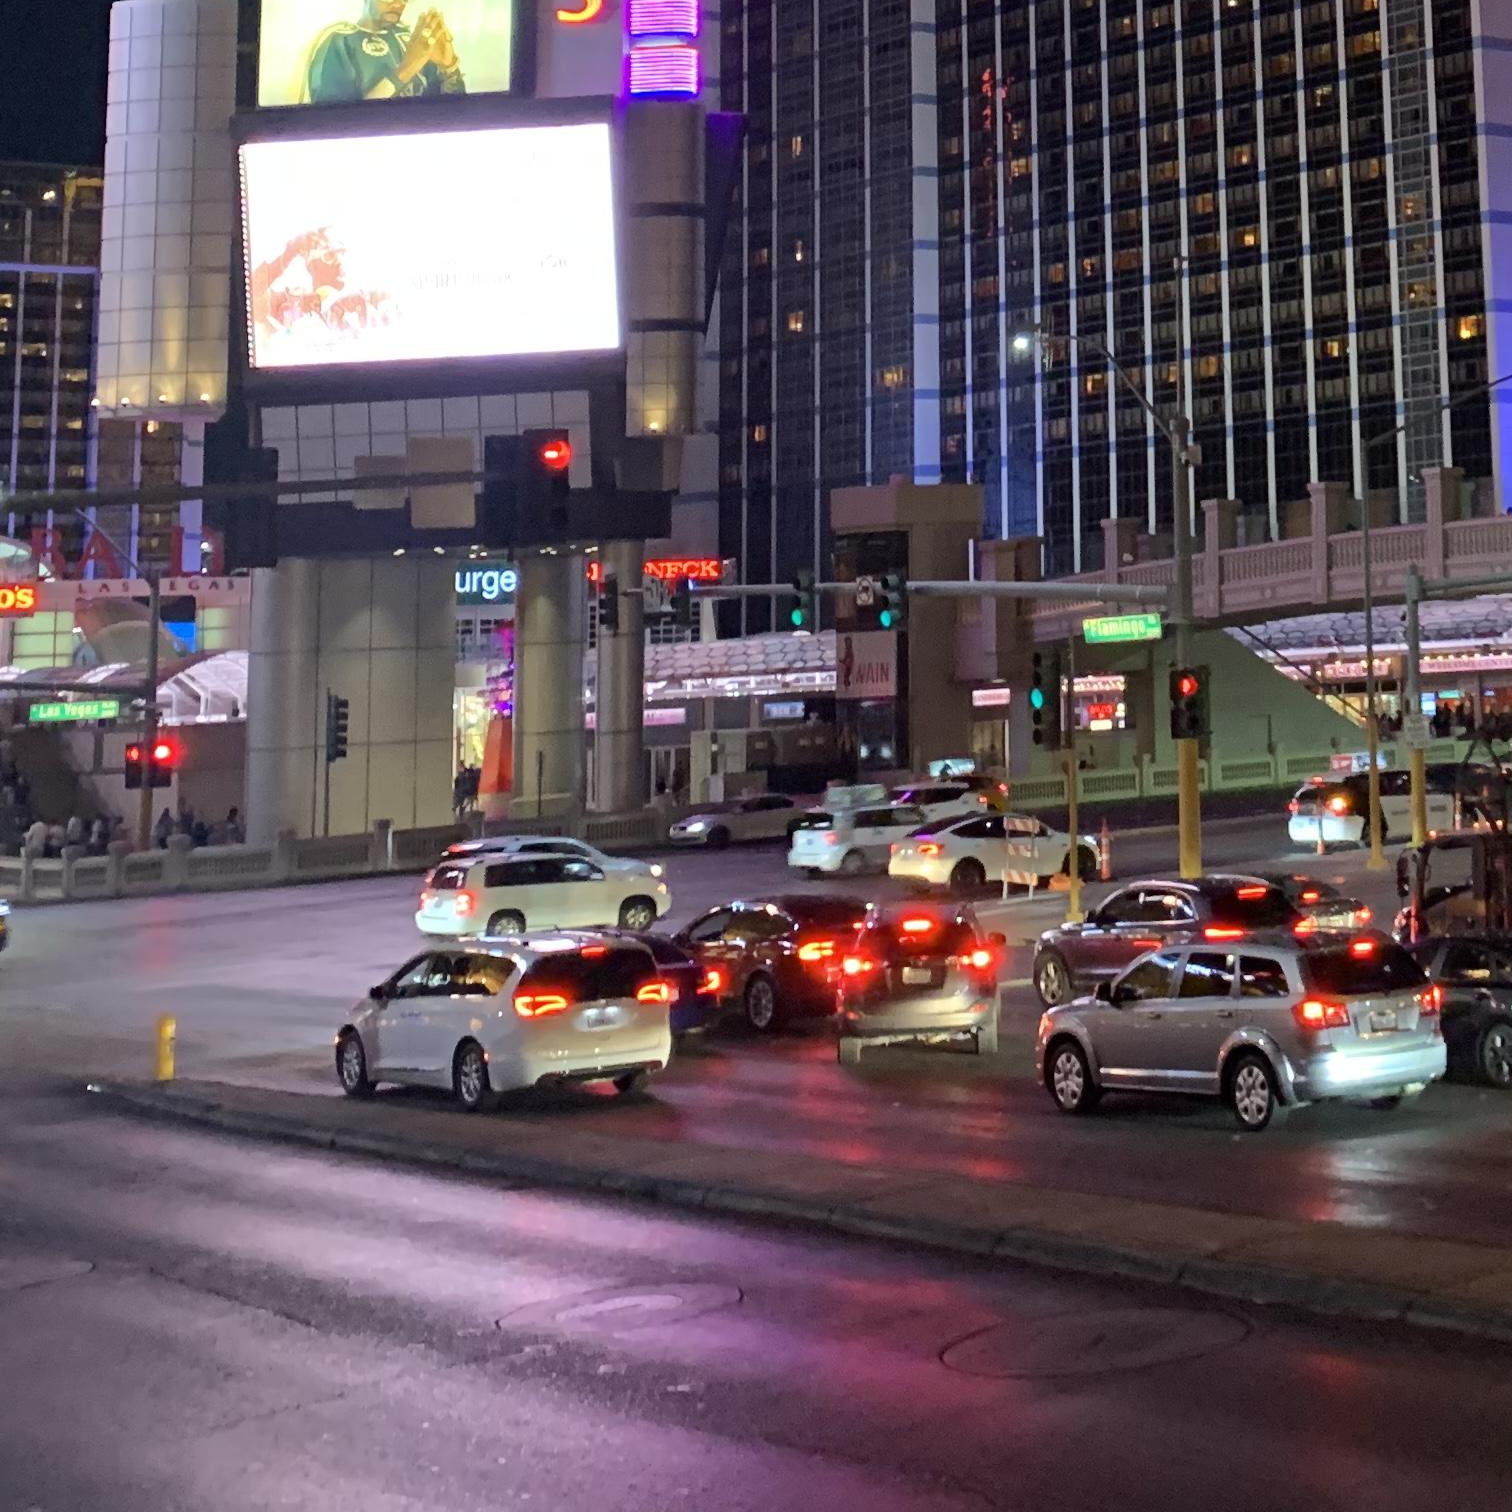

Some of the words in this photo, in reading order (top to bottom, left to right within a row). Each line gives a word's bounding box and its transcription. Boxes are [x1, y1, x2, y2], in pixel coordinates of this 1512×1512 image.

[643, 560, 719, 580] NECK
[166, 578, 236, 592] EGAS
[455, 569, 517, 599] urge
[1090, 620, 1146, 638] Flamingo
[39, 705, 61, 719] Las
[64, 702, 98, 719] Vegas
